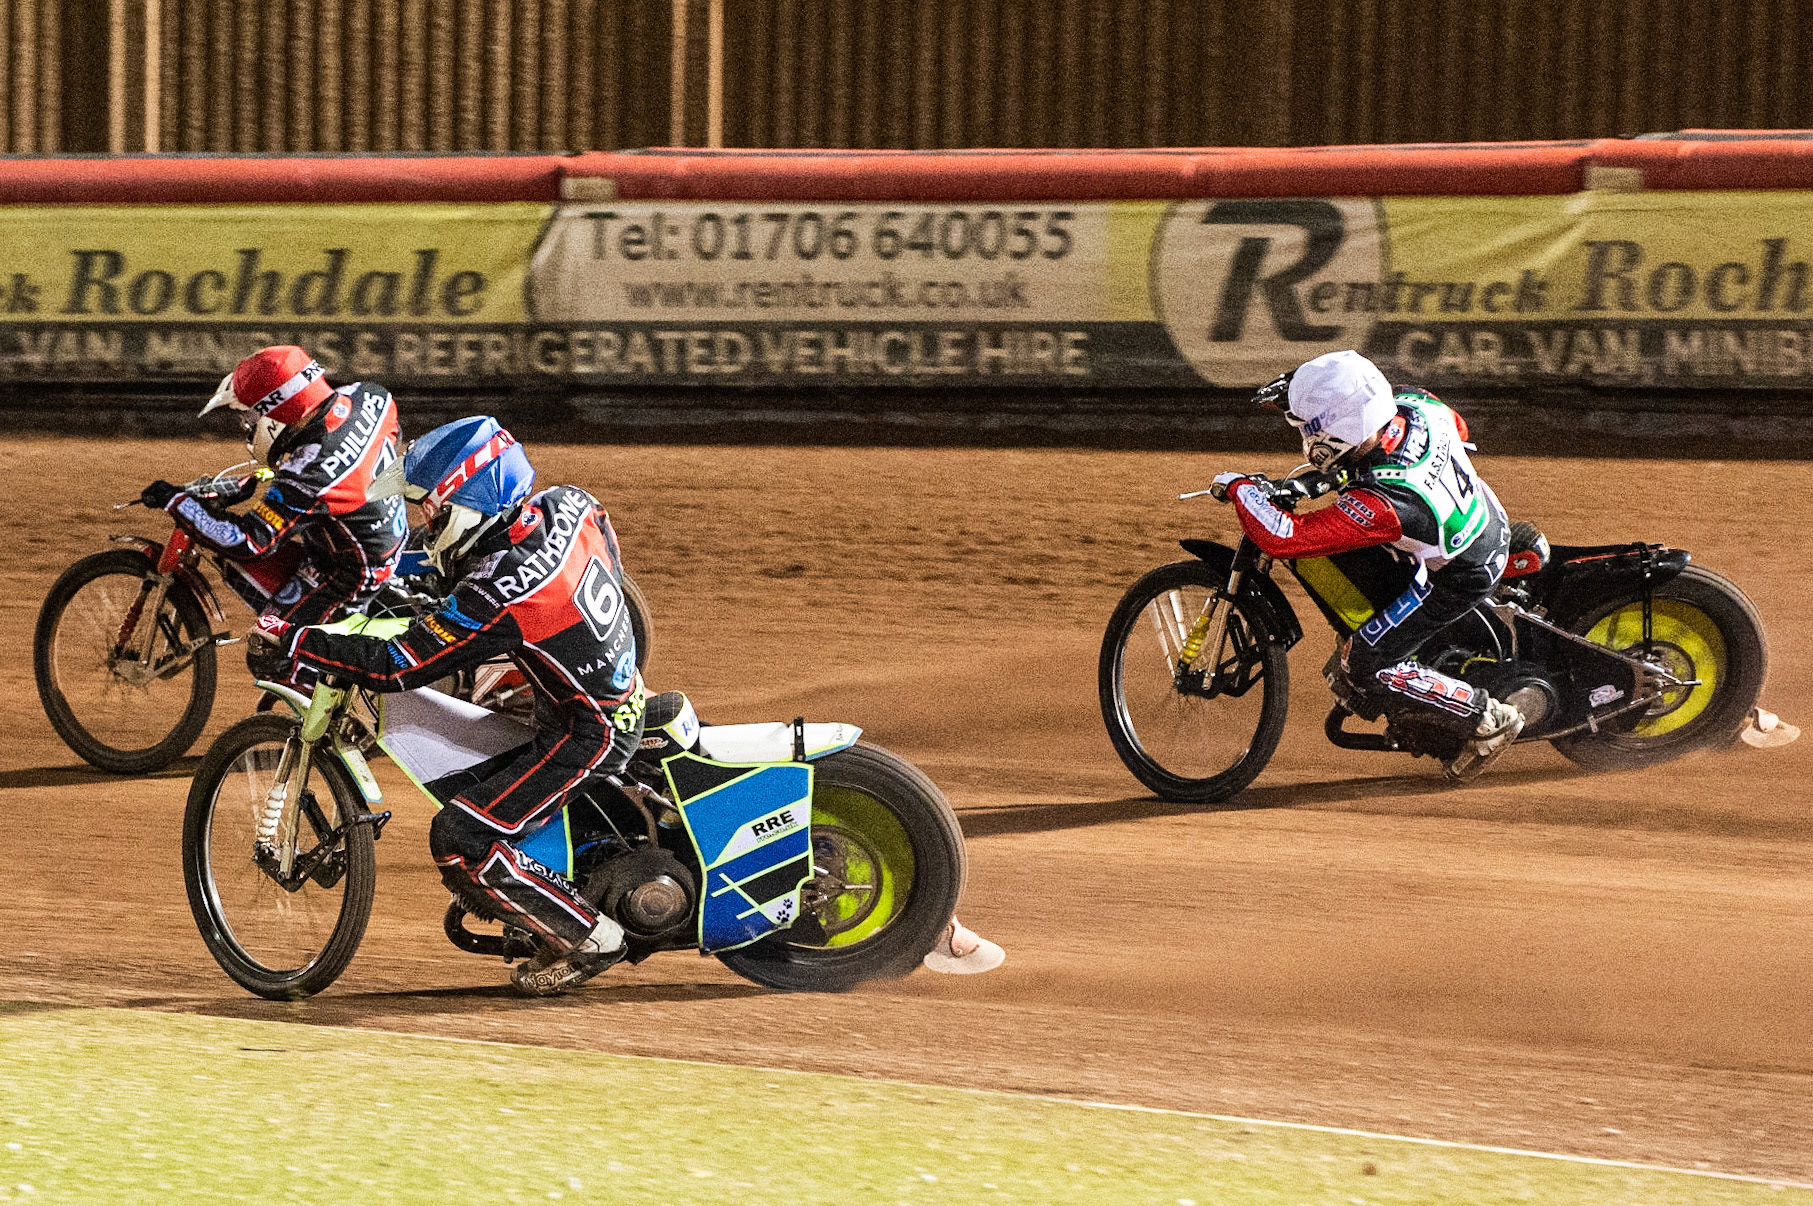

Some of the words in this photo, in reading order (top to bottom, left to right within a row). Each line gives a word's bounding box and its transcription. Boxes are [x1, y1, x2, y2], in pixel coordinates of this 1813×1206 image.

[583, 211, 680, 261] Tel:
[692, 211, 858, 261] 01706
[872, 211, 1076, 261] 640055
[60, 248, 486, 316] Rochdale
[624, 272, 1030, 308] www.rentruck.co.uk
[351, 331, 386, 375] &
[394, 331, 753, 375] REFRIGERATED
[758, 331, 966, 375] VEHICLE
[976, 331, 1092, 375] HIRE
[320, 391, 384, 479] PHILLIPS
[1450, 454, 1475, 500] 4
[495, 490, 587, 599] RATHBONE
[584, 563, 619, 626] 6
[751, 810, 795, 837] RRE
